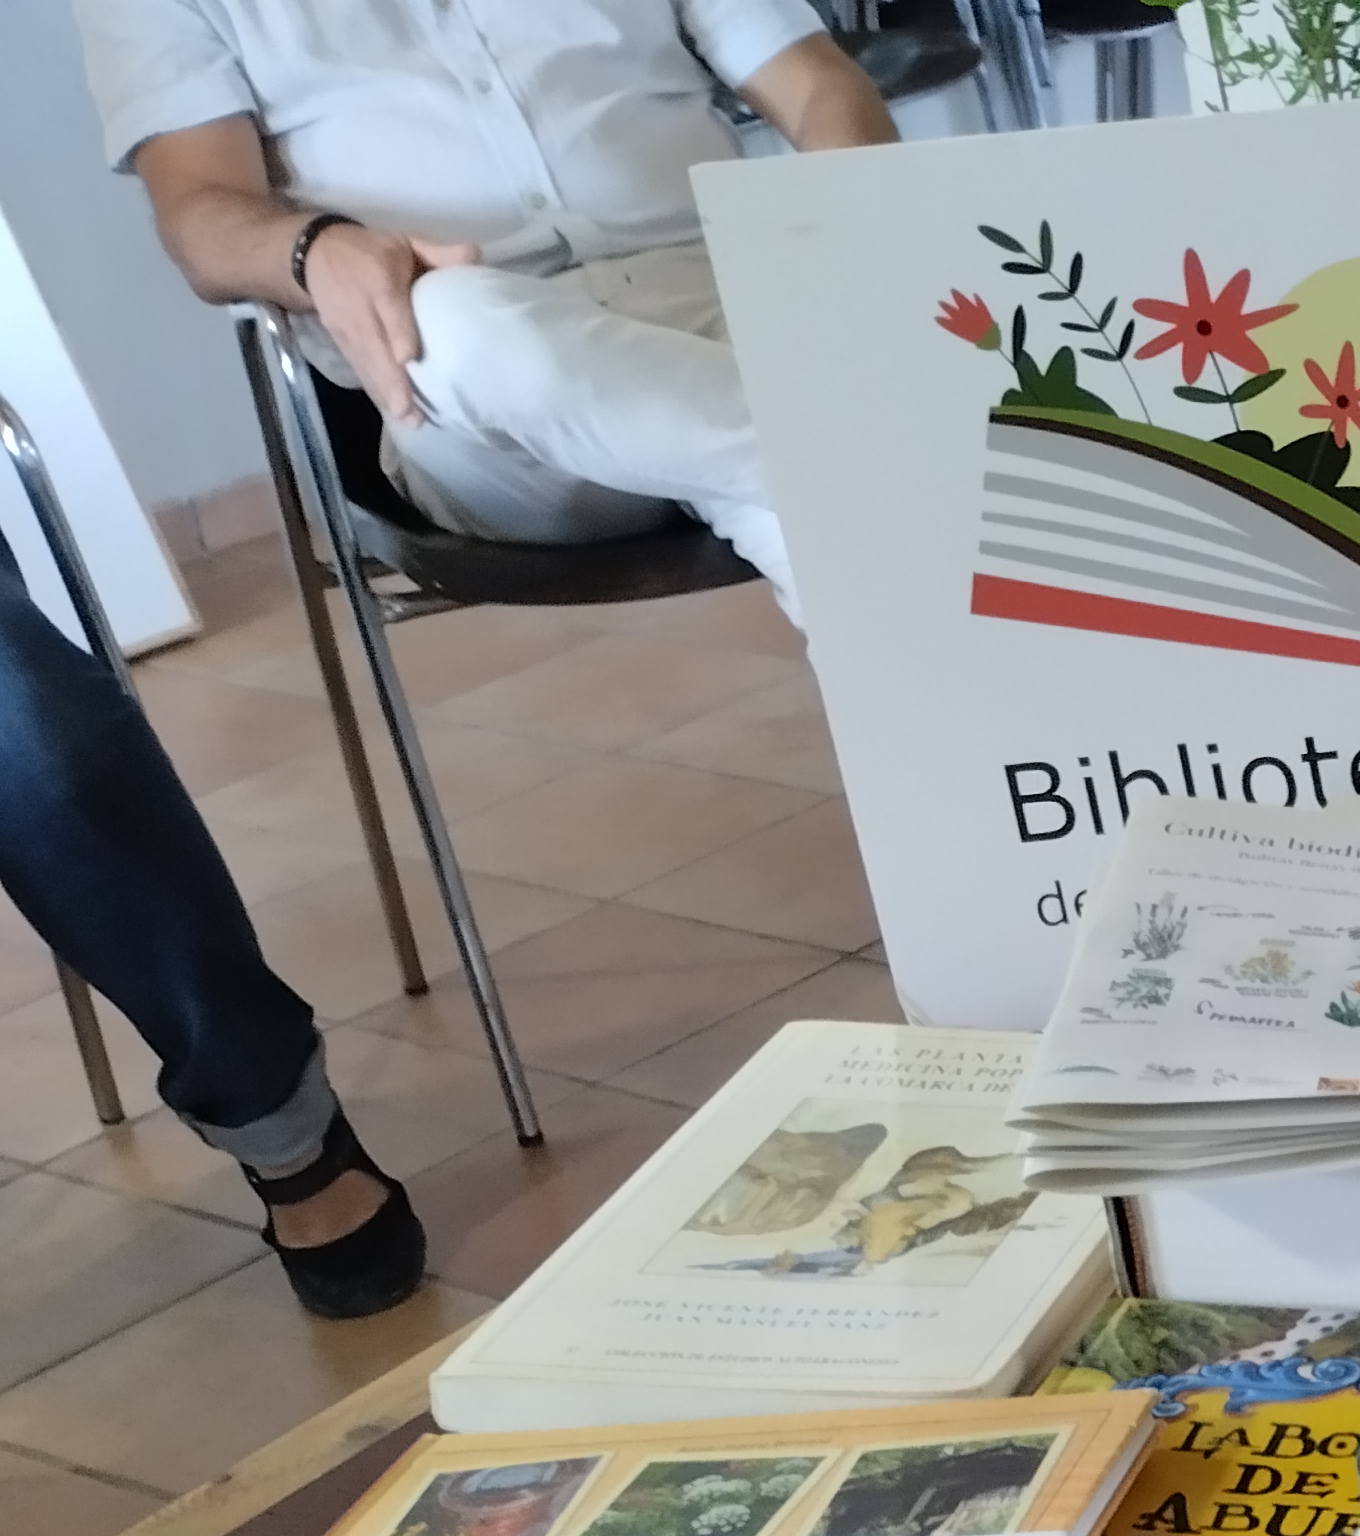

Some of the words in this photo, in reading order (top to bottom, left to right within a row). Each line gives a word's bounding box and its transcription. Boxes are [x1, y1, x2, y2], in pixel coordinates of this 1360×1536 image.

[1164, 821, 1275, 848] Cultiva
[861, 1076, 975, 1092] COMARCA
[1172, 1420, 1253, 1458] LA
[1222, 1462, 1340, 1500] DE
